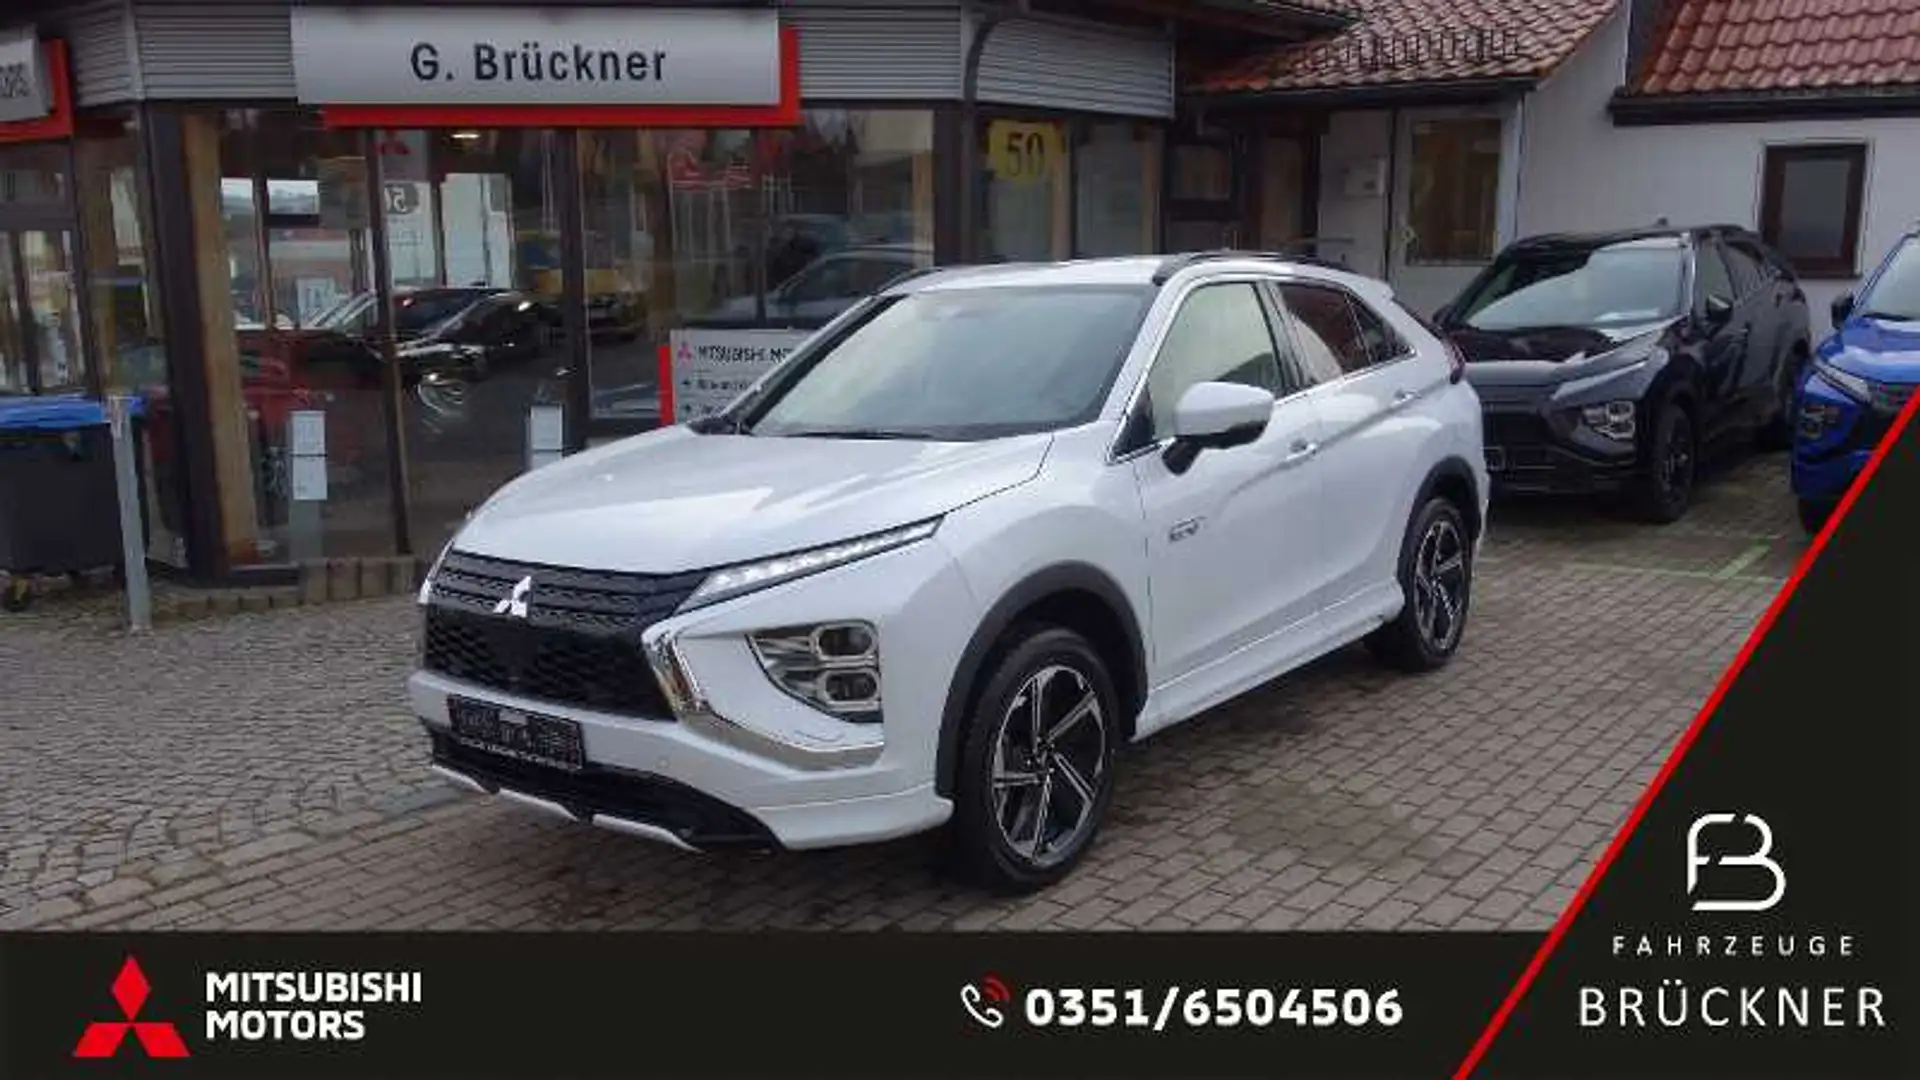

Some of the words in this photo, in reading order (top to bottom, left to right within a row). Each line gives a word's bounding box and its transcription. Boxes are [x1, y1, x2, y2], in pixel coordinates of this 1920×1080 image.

[411, 42, 454, 81] G.
[474, 42, 667, 81] Brückner
[1007, 132, 1045, 177] 50
